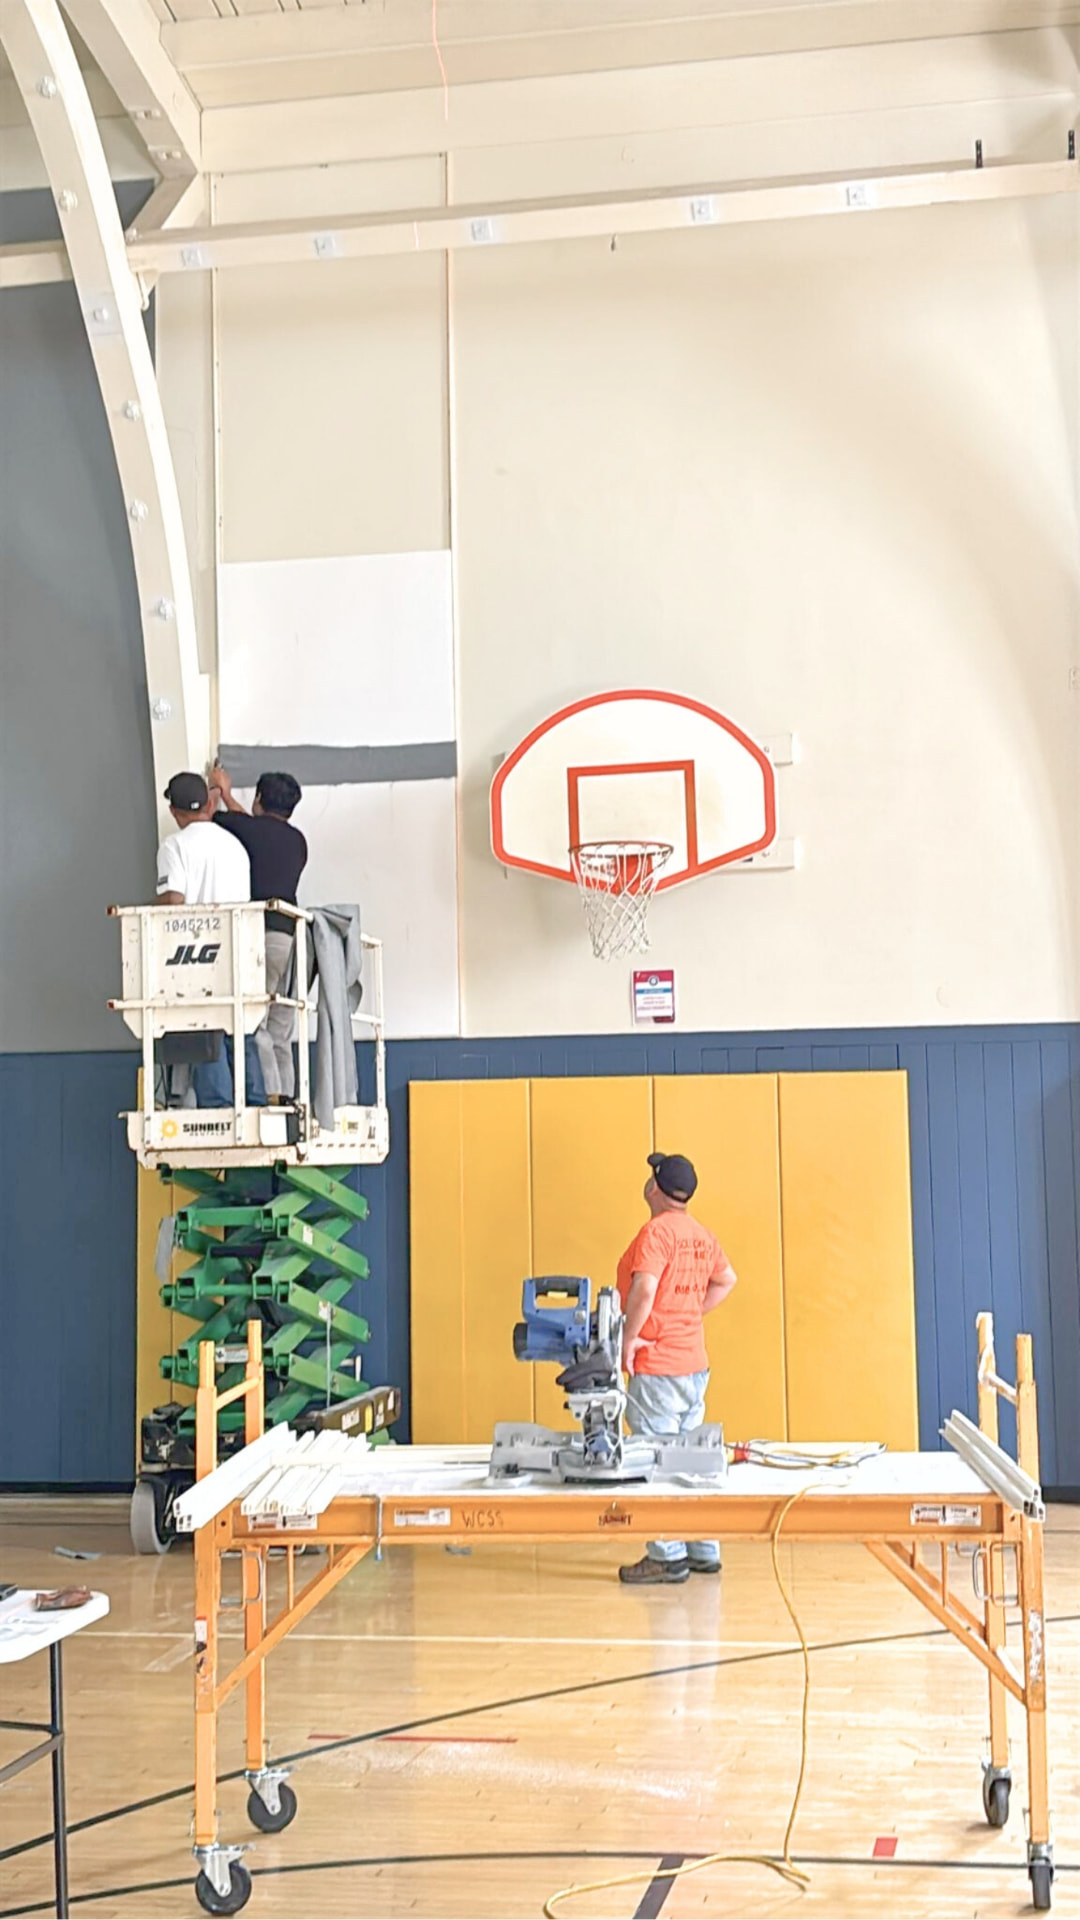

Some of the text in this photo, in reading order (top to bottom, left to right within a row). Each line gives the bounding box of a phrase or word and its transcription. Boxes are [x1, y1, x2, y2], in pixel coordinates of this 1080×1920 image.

[165, 918, 220, 932] 1045212
[165, 943, 221, 966] JLG
[183, 1122, 232, 1132] SUNBELT
